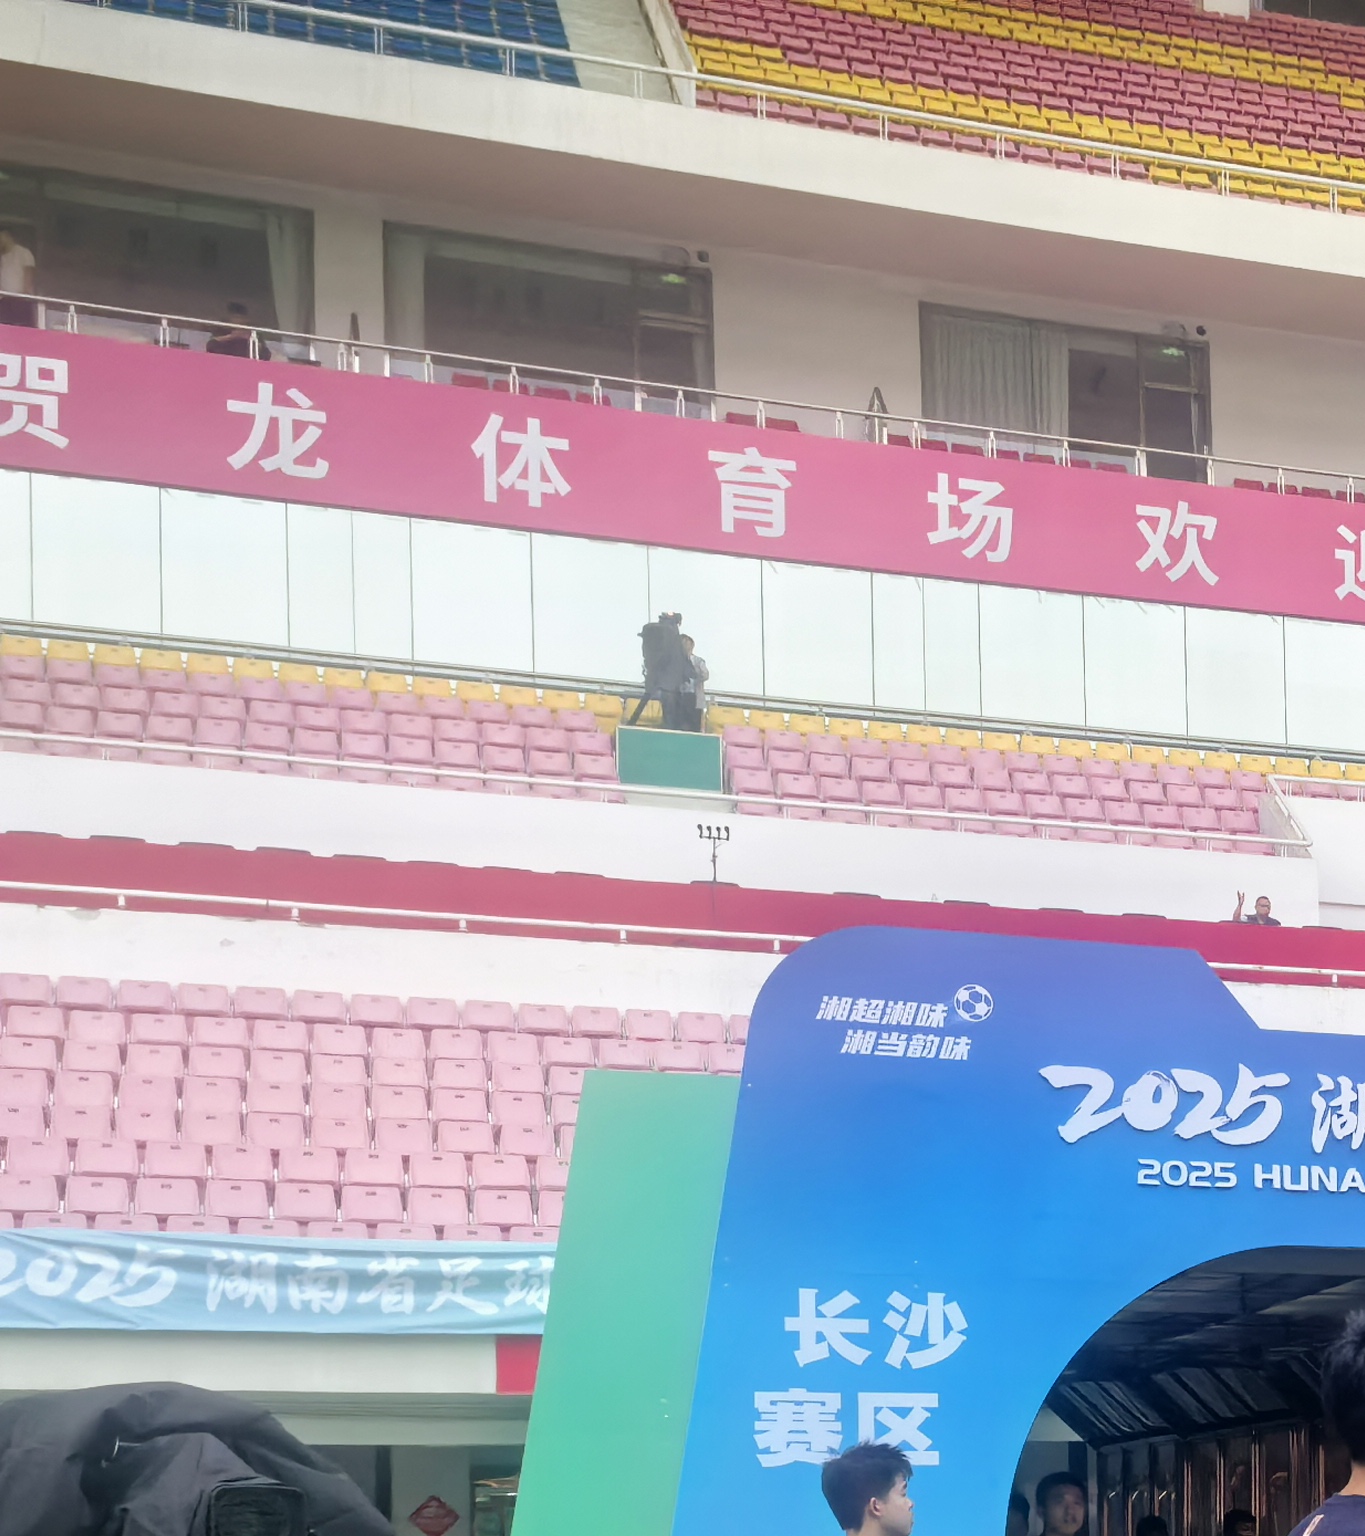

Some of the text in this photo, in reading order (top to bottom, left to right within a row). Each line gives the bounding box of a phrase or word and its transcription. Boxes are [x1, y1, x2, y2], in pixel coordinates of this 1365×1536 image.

[816, 995, 949, 1028] 湘超湘味
[840, 1029, 972, 1061] 湘当韵味
[1039, 1063, 1290, 1146] 2025
[1137, 1159, 1238, 1190] 2025
[784, 1288, 969, 1370] 长沙
[753, 1387, 940, 1468] 赛区
